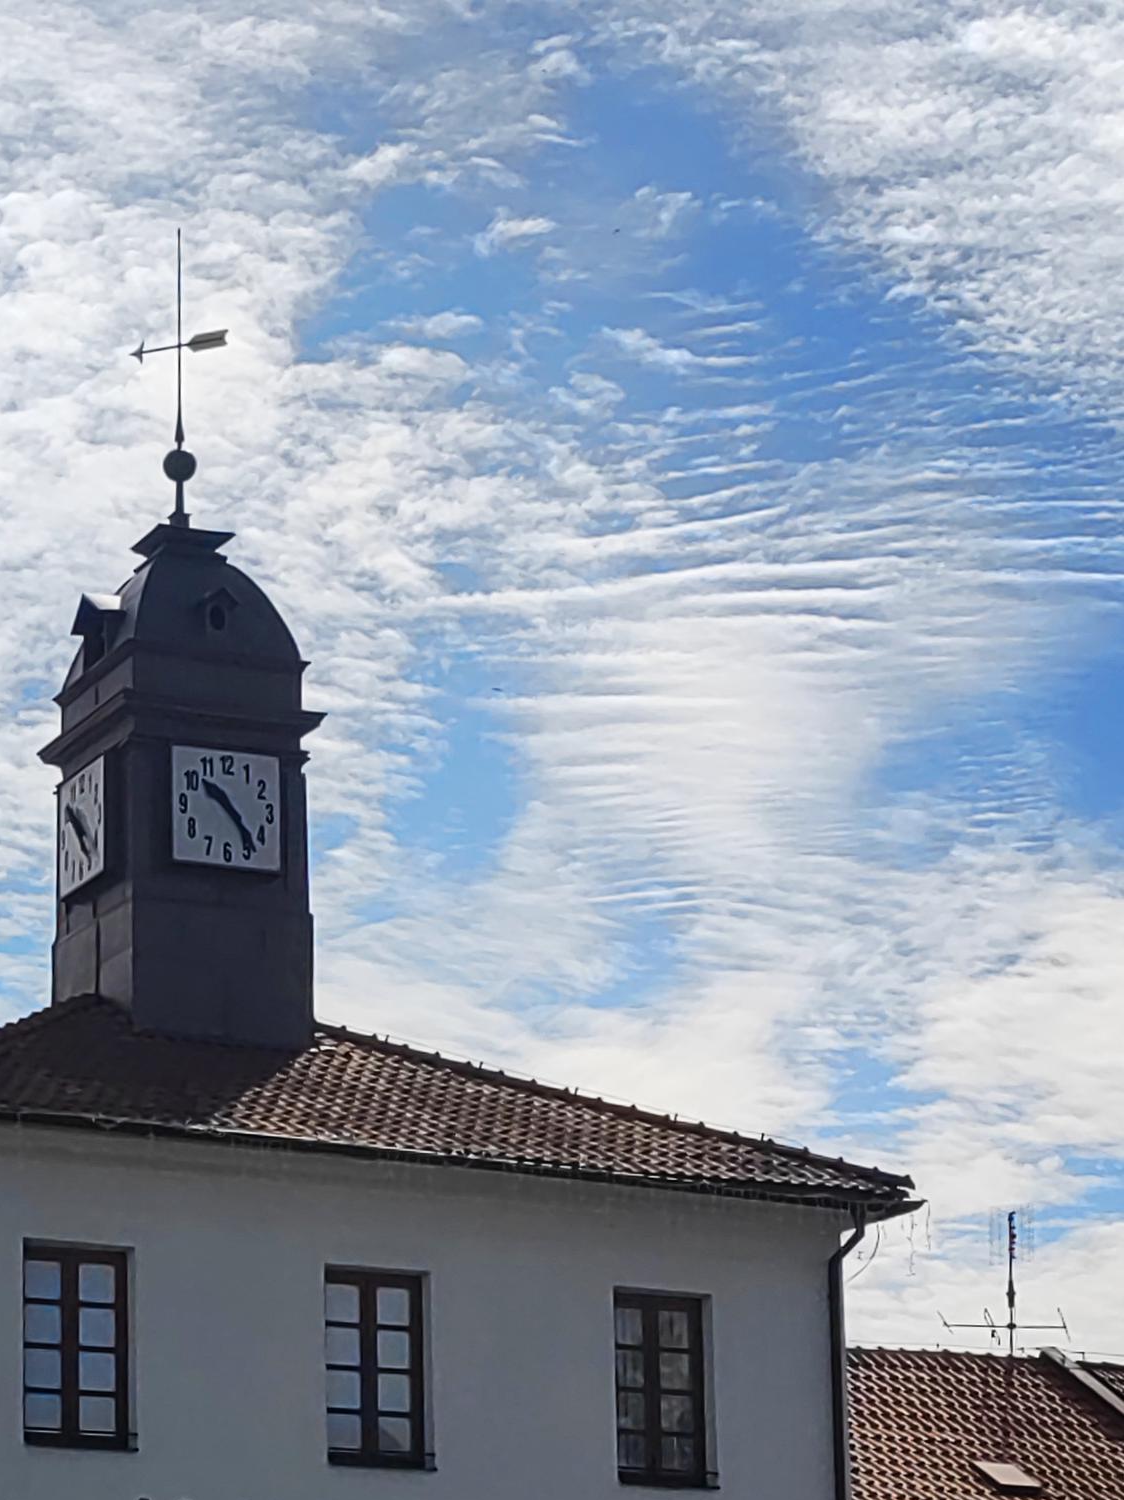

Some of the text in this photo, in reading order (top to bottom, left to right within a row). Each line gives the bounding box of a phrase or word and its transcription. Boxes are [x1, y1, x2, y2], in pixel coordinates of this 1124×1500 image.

[201, 757, 214, 777] 11
[220, 756, 235, 776] 12
[243, 764, 250, 784] 1
[184, 770, 199, 791] 10
[257, 780, 266, 800] 2
[179, 793, 188, 814] 9
[265, 804, 274, 825] 3
[187, 817, 196, 838] 8
[257, 825, 265, 846] 4
[204, 836, 213, 856] 7
[222, 842, 232, 863] 6
